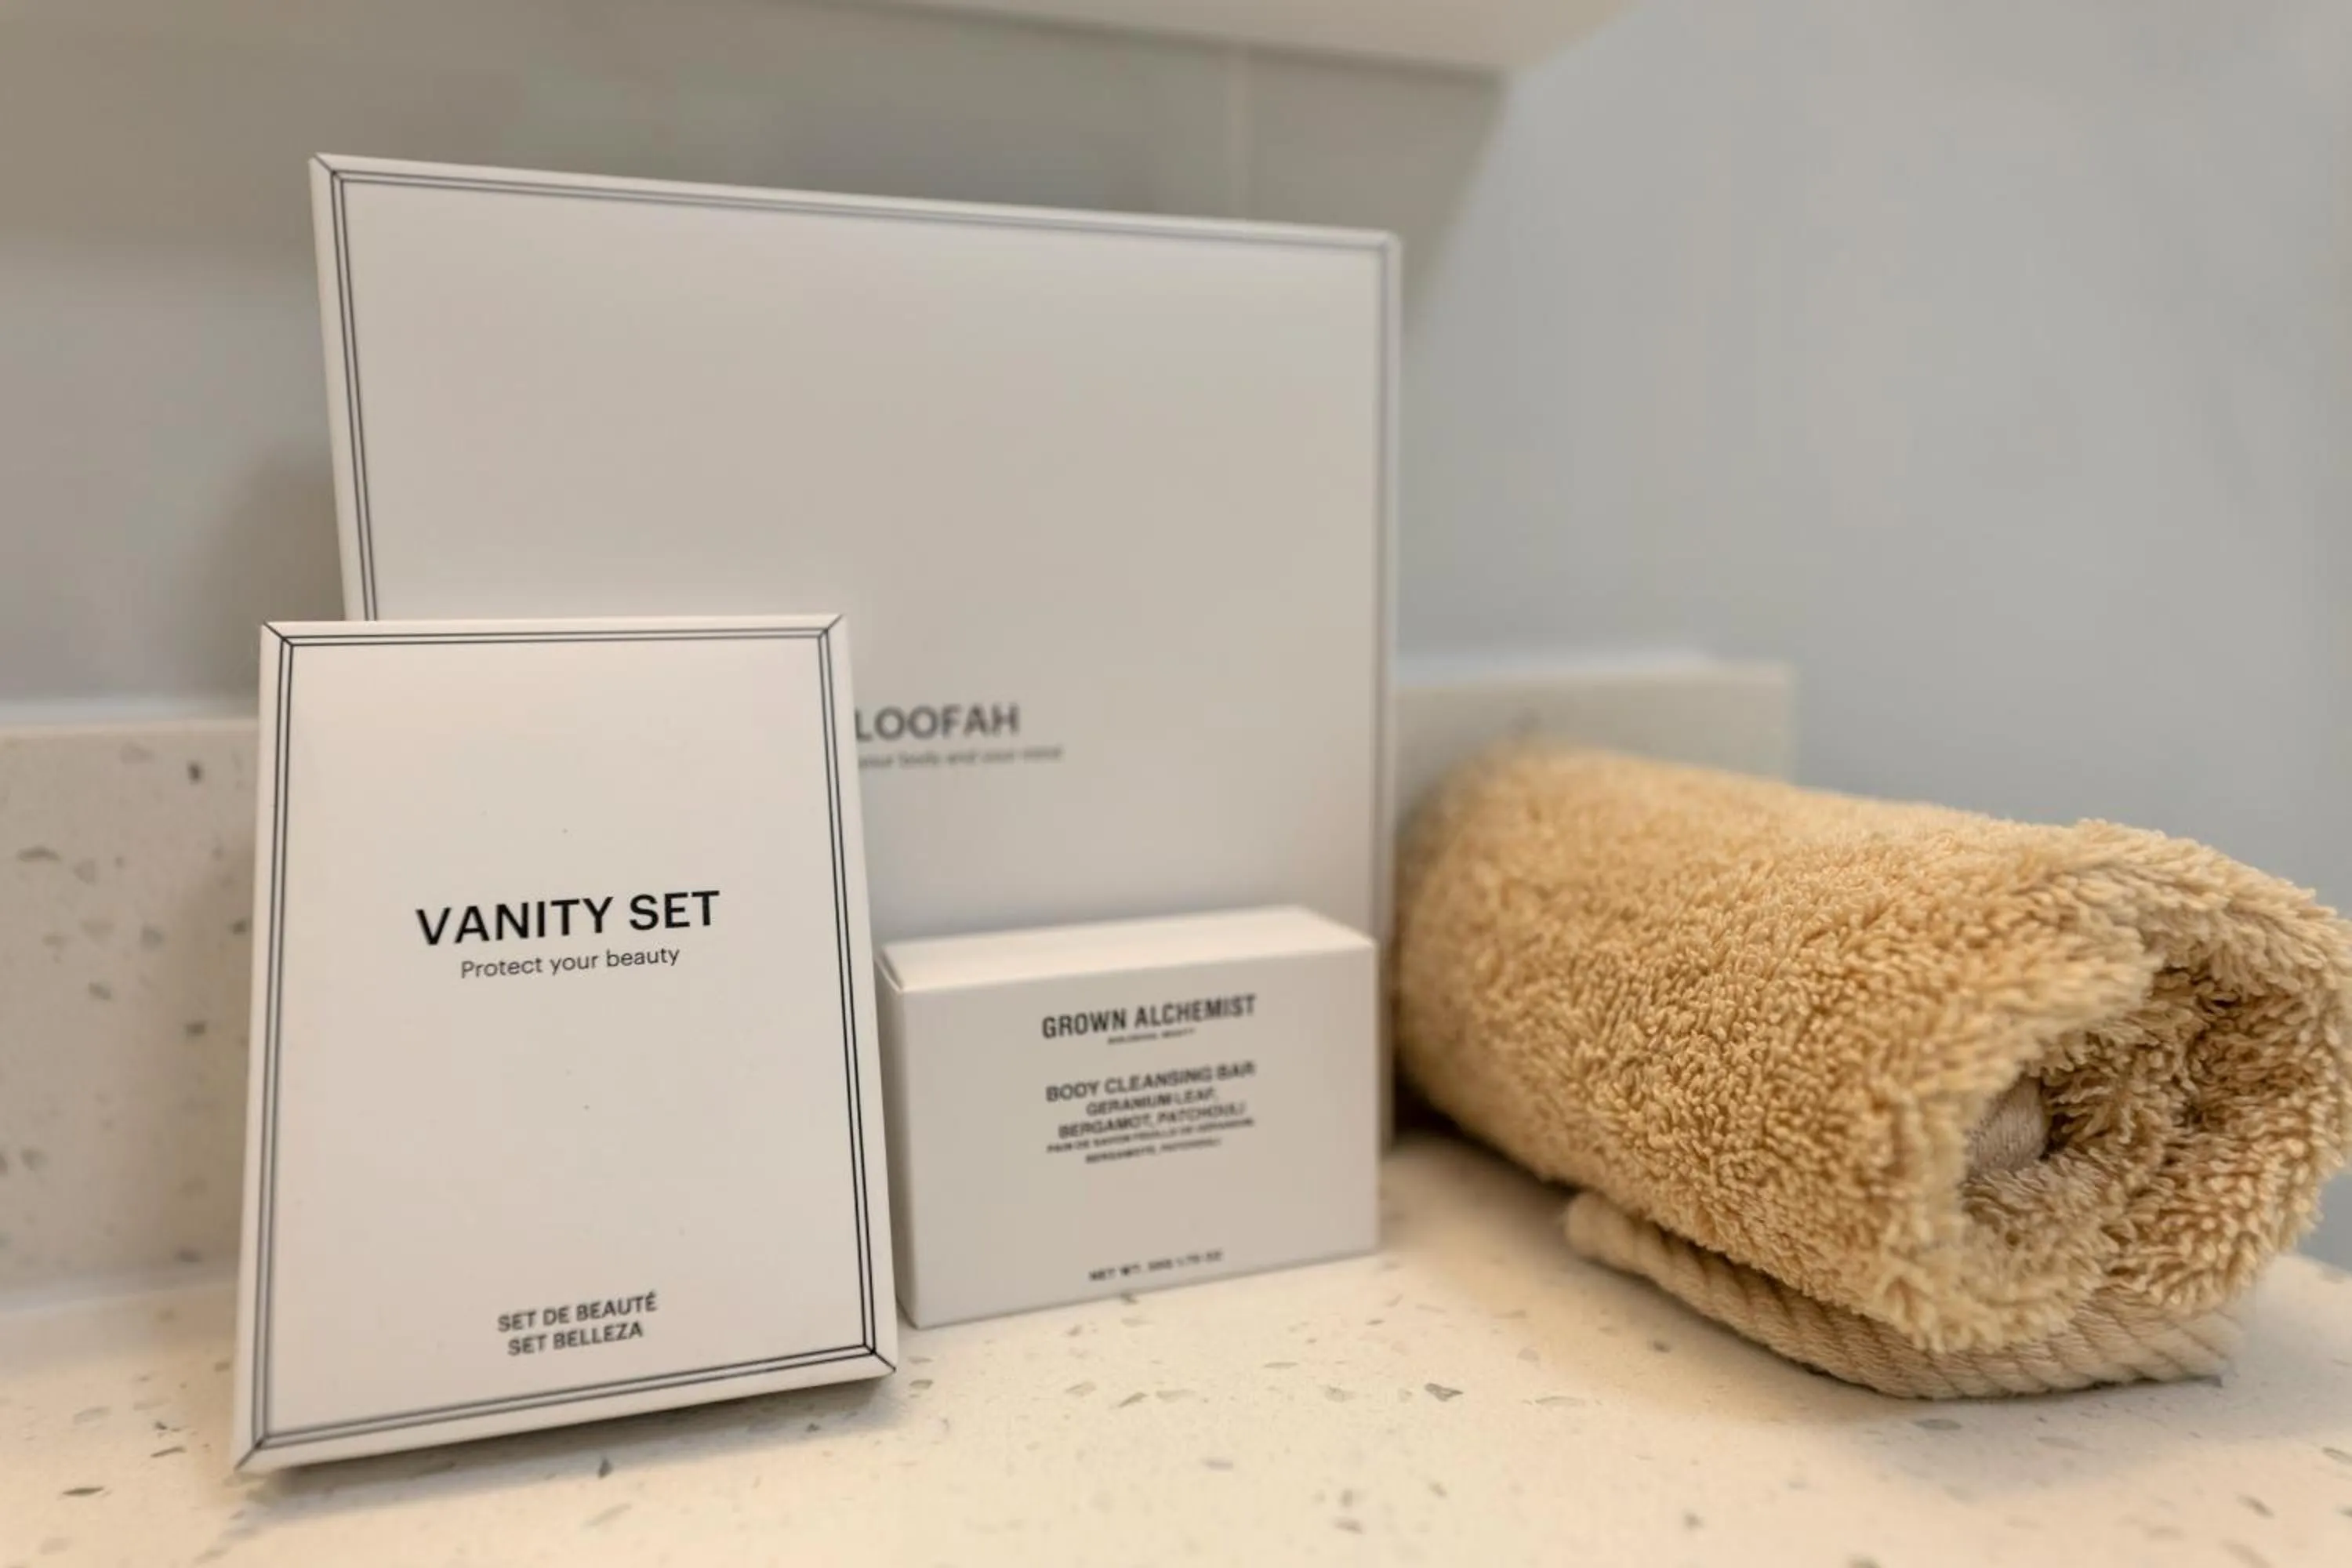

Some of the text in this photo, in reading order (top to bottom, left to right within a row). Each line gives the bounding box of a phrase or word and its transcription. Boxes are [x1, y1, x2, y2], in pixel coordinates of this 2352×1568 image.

[855, 703, 1019, 741] LOOFAH
[416, 890, 720, 946] VANITY SET
[461, 947, 681, 978] Protect your beauty
[1041, 1008, 1127, 1039] GROWN
[1134, 993, 1257, 1028] ALCHEMIST
[1045, 1061, 1256, 1102] BODY CLEANSING BAR
[1085, 1092, 1172, 1116] GERANIUM
[497, 1290, 657, 1333] SET DE BEAUTÉ
[507, 1320, 644, 1356] SET BELLEZA
